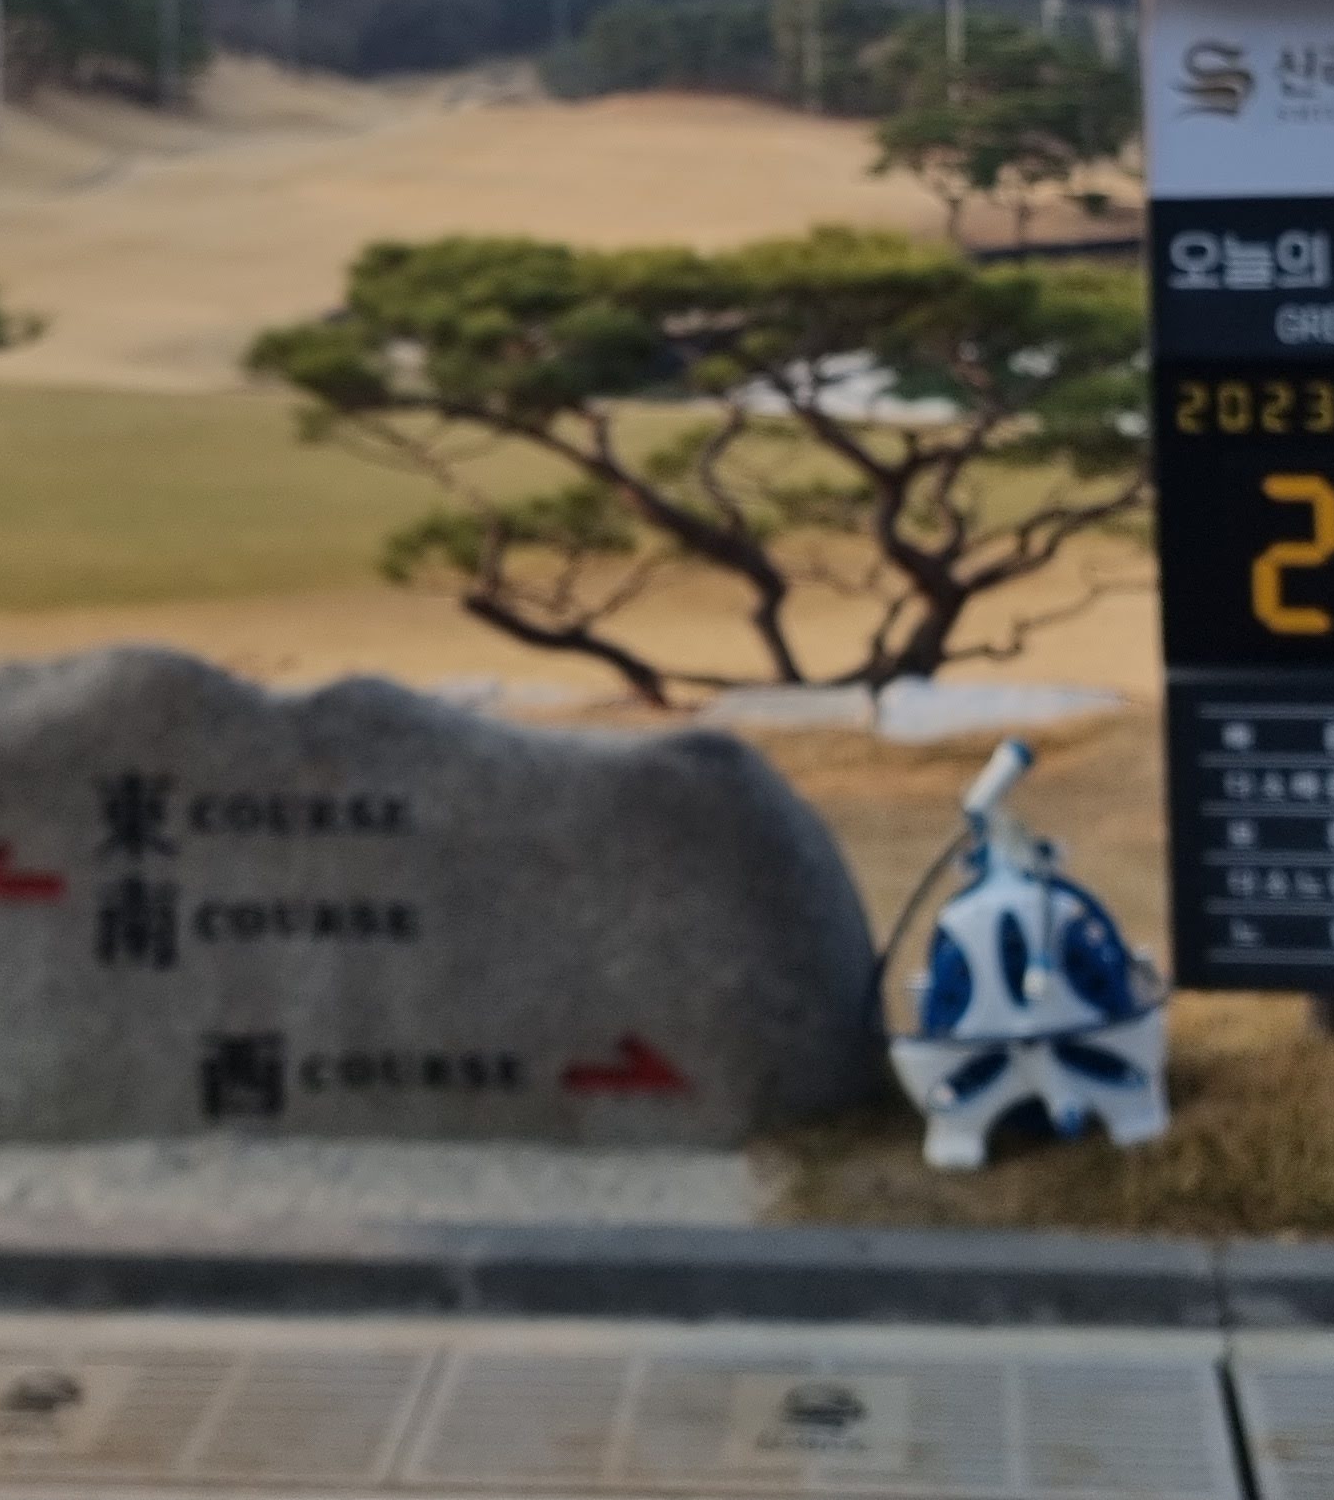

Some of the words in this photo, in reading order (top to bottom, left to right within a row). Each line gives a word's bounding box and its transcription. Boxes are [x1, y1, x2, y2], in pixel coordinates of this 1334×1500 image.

[1169, 229, 1332, 290] 오늘의
[189, 793, 415, 836] COURSE
[192, 899, 419, 943] COURSE
[298, 1053, 525, 1092] COURSE
